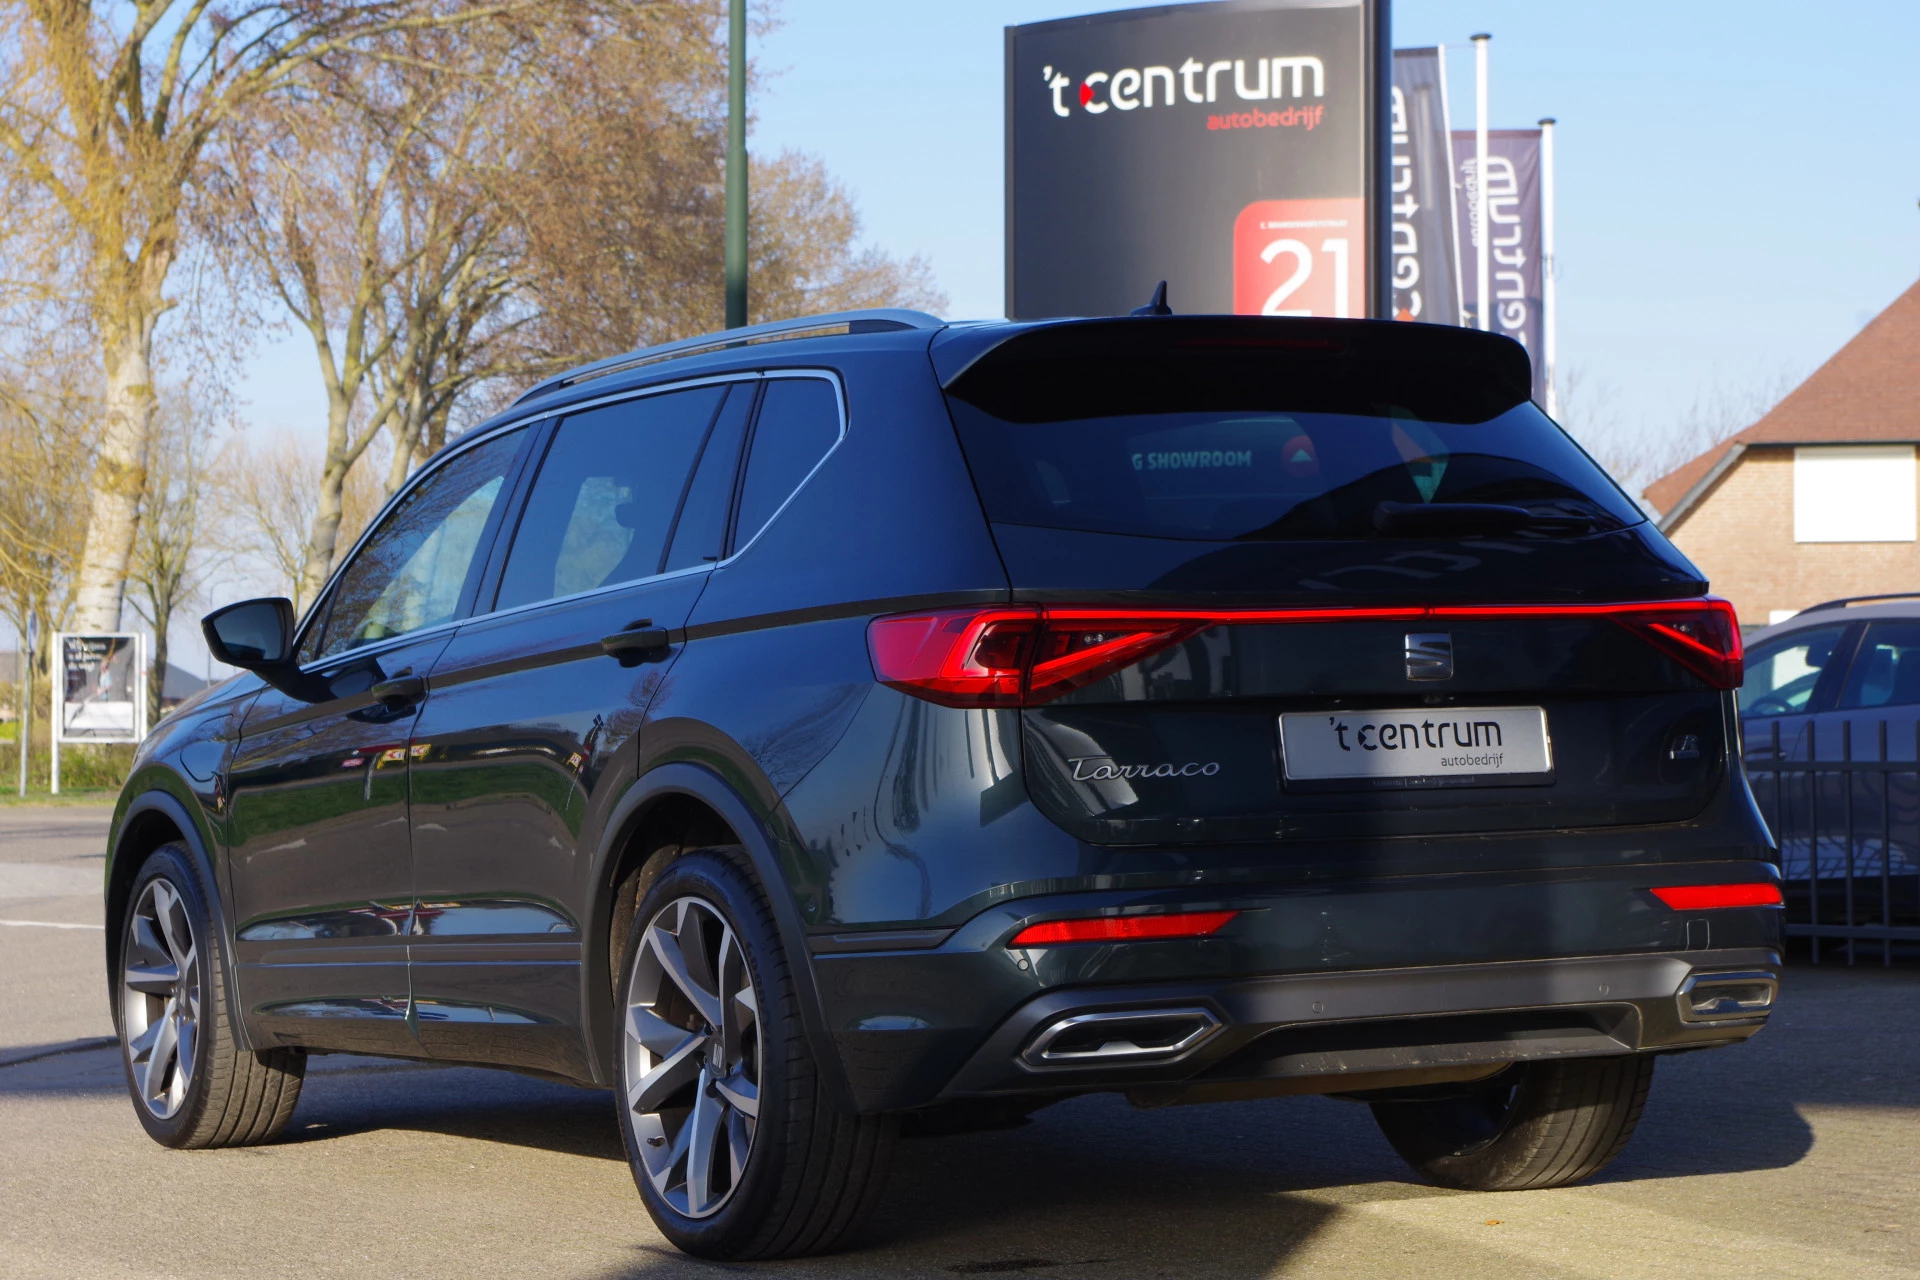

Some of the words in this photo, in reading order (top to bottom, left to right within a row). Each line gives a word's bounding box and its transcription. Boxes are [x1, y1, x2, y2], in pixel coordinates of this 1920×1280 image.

[1079, 56, 1325, 115] centrum
[1206, 104, 1325, 131] autobedrijf
[1260, 238, 1349, 318] 21
[1147, 449, 1253, 469] SHOWROOM
[1357, 721, 1503, 751] centrum
[1067, 755, 1221, 781] Tarraco
[1440, 752, 1504, 769] autobedrijf
